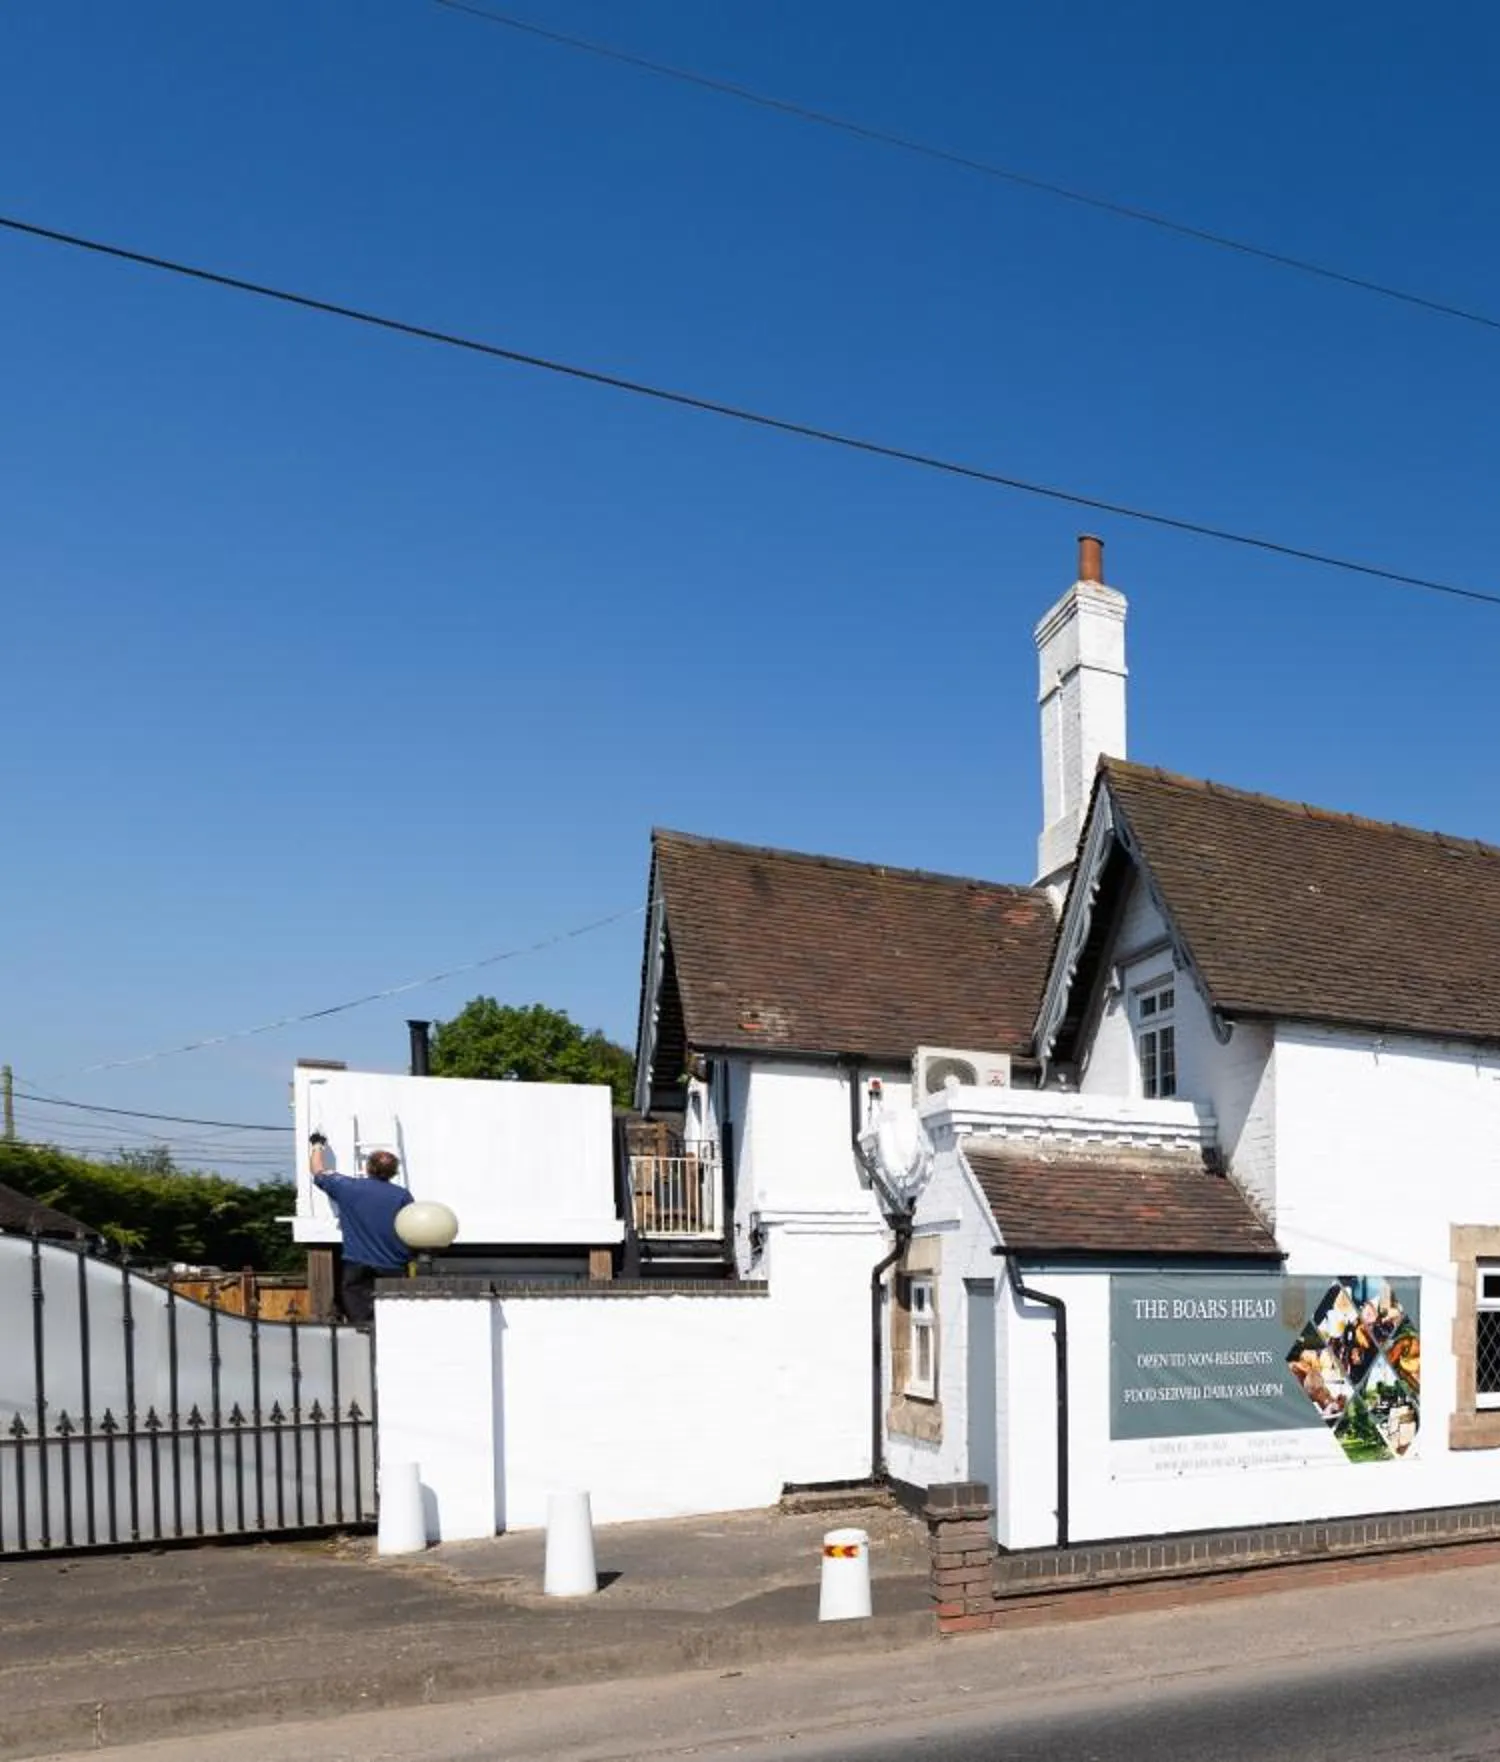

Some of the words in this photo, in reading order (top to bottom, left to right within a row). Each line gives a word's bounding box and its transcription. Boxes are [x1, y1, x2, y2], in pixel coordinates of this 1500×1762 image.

[1134, 1298, 1169, 1319] THE
[1172, 1298, 1228, 1319] BOARS
[1231, 1298, 1277, 1319] HEAD
[1136, 1352, 1168, 1368] OPEN
[1168, 1352, 1185, 1367] TO
[1123, 1387, 1157, 1403] FOOD
[1158, 1385, 1201, 1401] SERVED
[1203, 1384, 1235, 1400] DAILY
